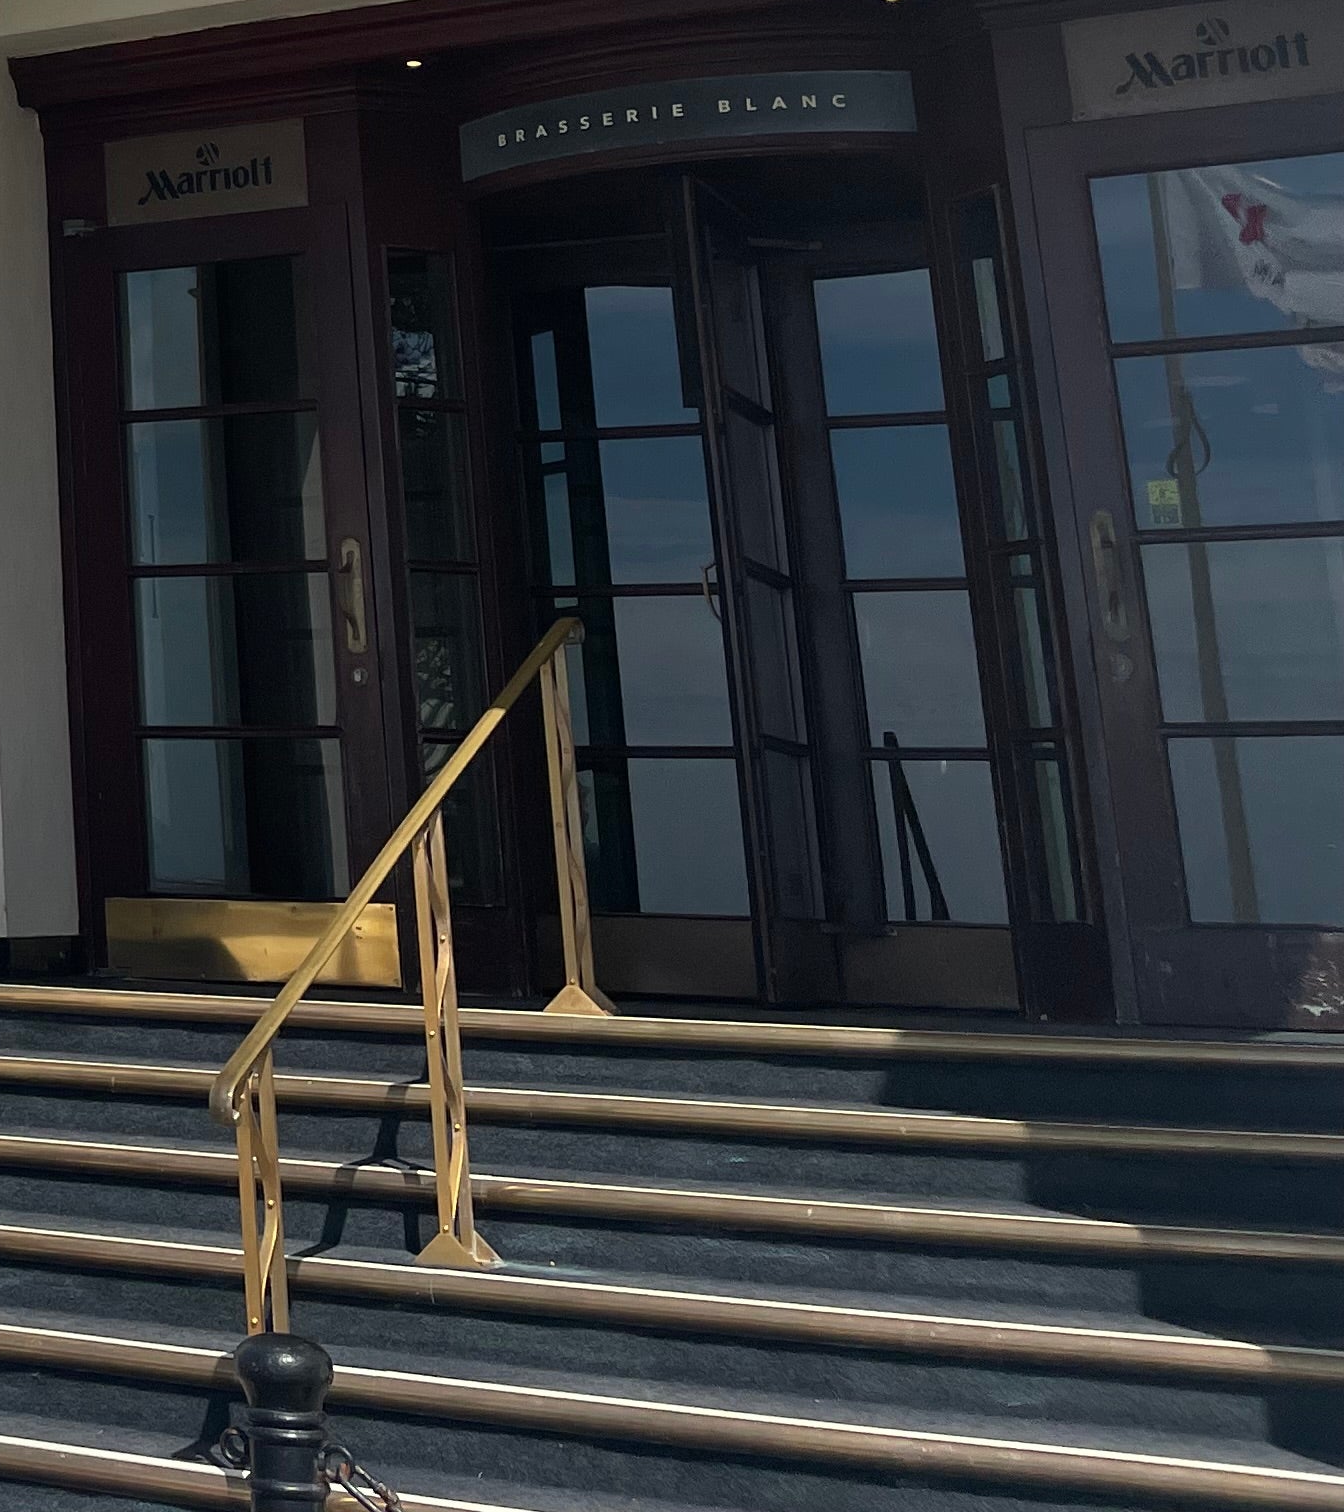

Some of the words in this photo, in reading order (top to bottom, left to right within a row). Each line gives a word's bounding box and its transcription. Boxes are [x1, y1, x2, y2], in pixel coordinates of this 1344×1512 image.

[1115, 31, 1311, 95] Marriott
[496, 102, 685, 147] BRASSERIE
[717, 93, 848, 114] BLANC
[138, 156, 273, 206] Marriott
